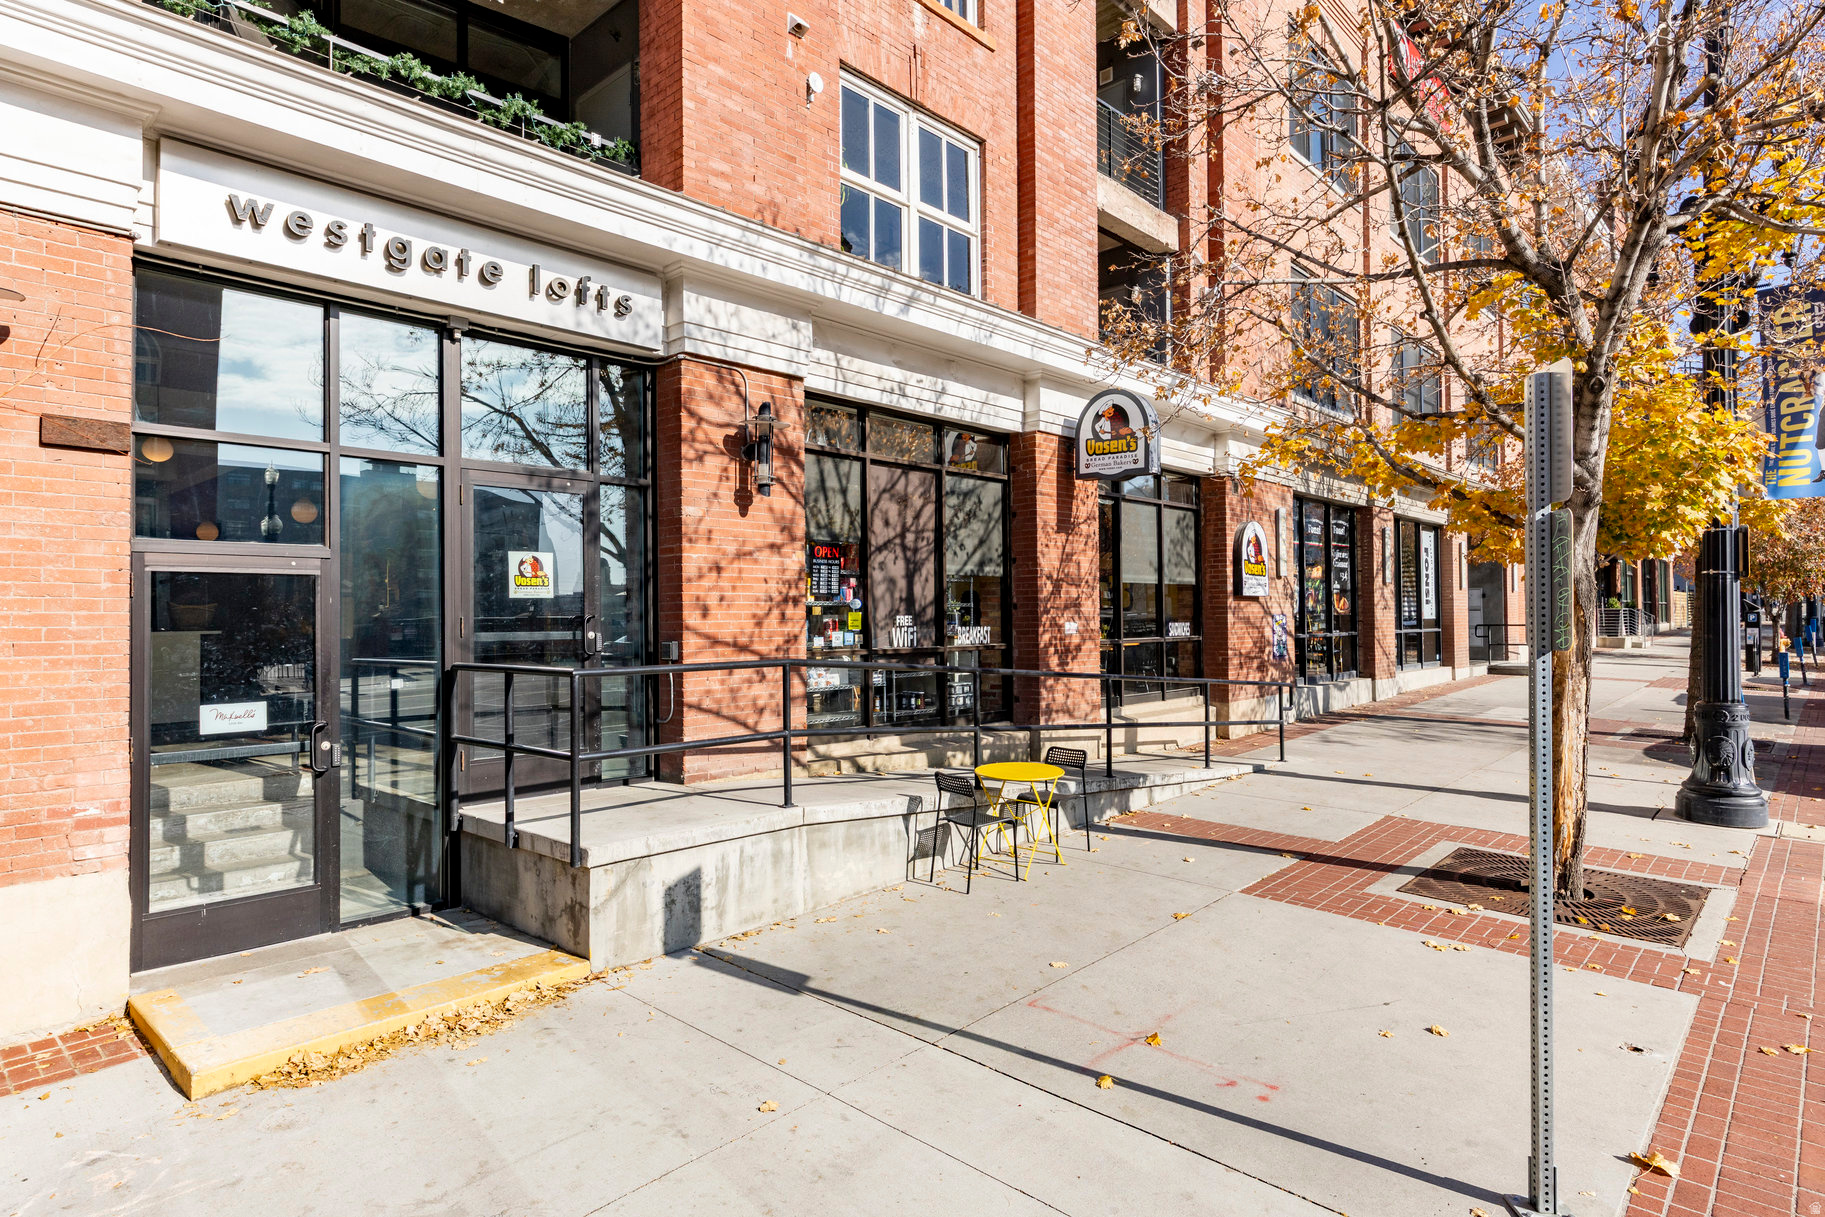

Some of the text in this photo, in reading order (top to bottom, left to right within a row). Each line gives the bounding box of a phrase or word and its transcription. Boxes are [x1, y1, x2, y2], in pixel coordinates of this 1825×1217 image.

[227, 193, 633, 316] westgate lofts
[1087, 436, 1138, 456] Vosen's
[1765, 469, 1777, 486] THE
[814, 545, 839, 558] OPEN
[514, 575, 549, 586] Vosen's
[896, 615, 913, 626] FREE
[892, 626, 917, 648] WiFi
[957, 626, 991, 644] BREAKFAST
